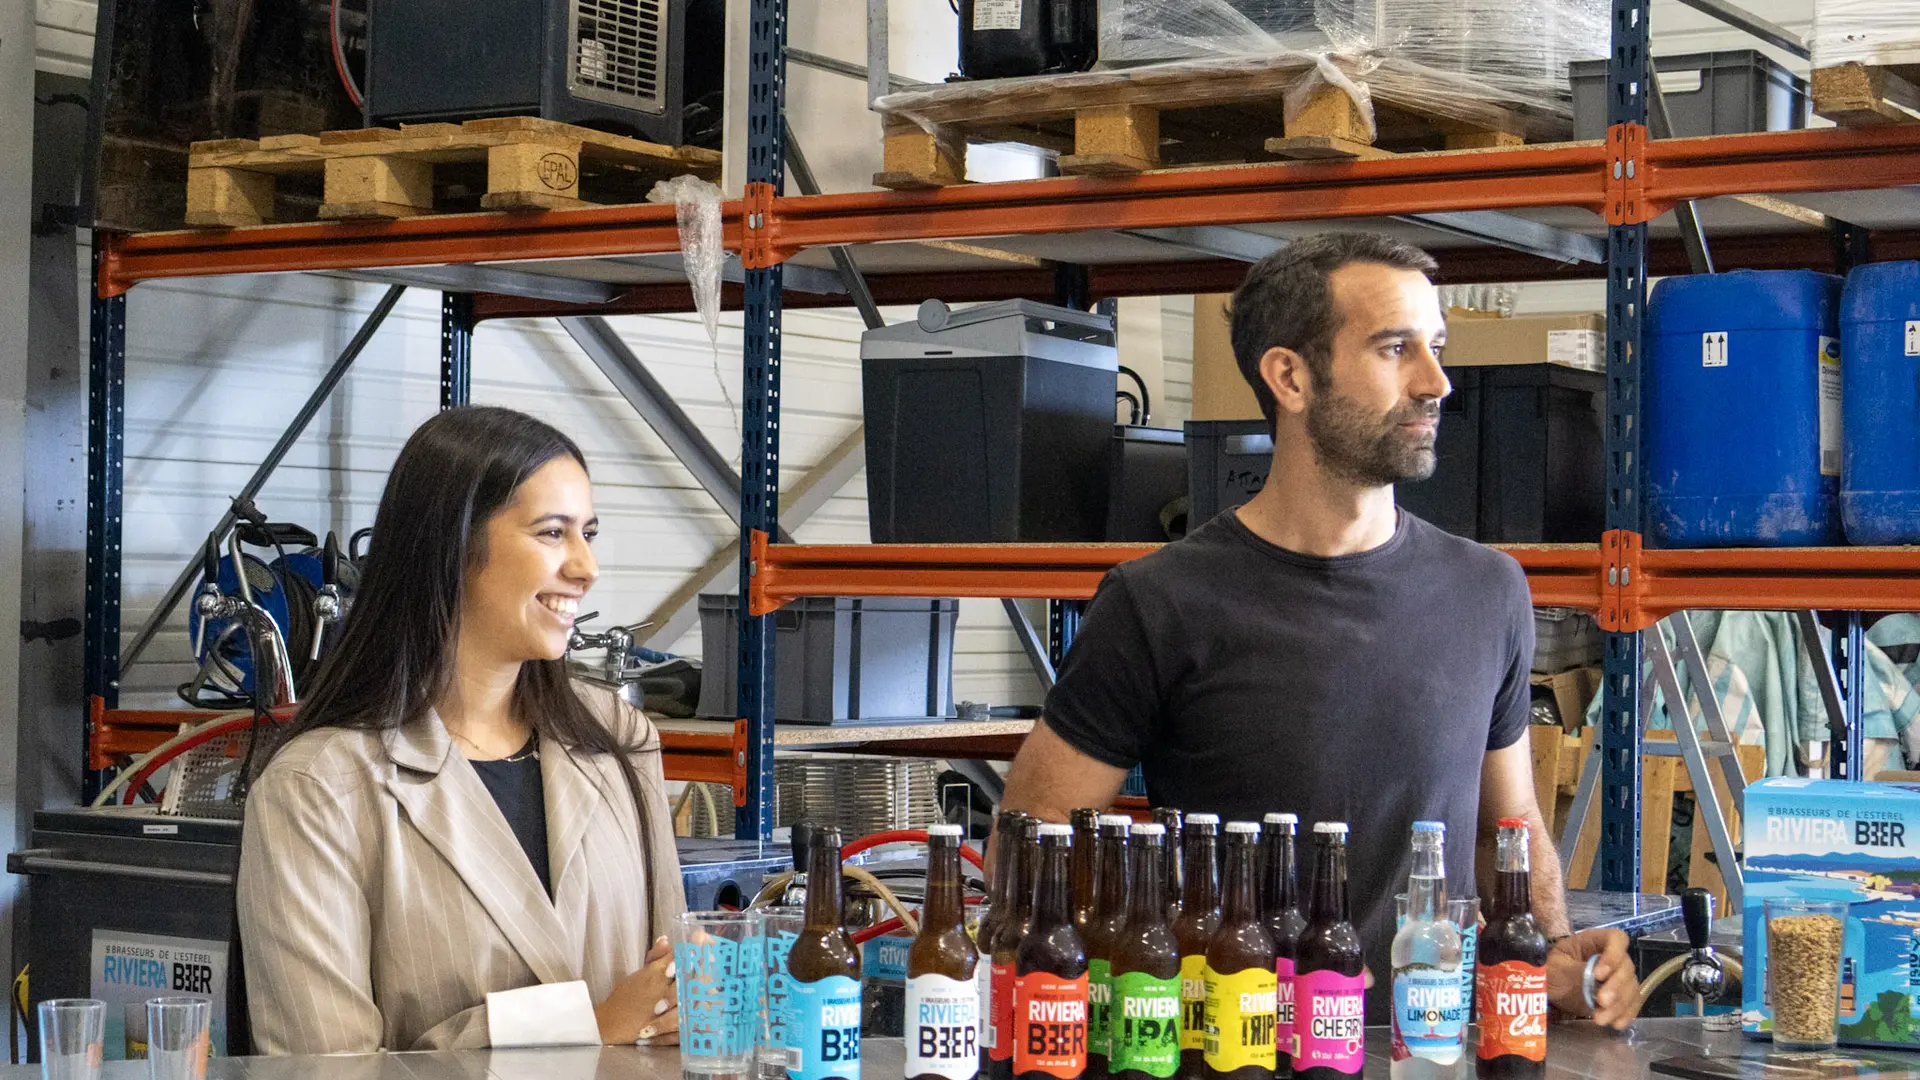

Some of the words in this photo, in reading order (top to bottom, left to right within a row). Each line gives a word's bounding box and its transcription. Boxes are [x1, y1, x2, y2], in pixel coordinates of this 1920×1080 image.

[543, 160, 572, 183] EPAL
[1776, 807, 1831, 818] BRASSEURS
[1837, 810, 1850, 818] DE
[1856, 810, 1905, 821] L'ESTEREL
[1767, 816, 1849, 844] RIVIERA
[1855, 820, 1905, 847] BEER
[112, 945, 154, 958] BRASSEURS
[159, 950, 169, 959] DE
[174, 951, 212, 964] L'ESTEREL
[104, 955, 168, 989] RIVIERA
[173, 963, 212, 994] BEER
[919, 1003, 975, 1024] RIVIERA
[1028, 1000, 1085, 1022] RIVIERA
[1124, 996, 1179, 1018] RIVIERA
[1408, 1009, 1460, 1021] LIMONADE
[1124, 1018, 1178, 1047] IPA
[1509, 1012, 1546, 1036] Cola
[821, 1027, 861, 1062] BEE
[919, 1025, 976, 1058] BEER
[1027, 1023, 1084, 1056] BEER
